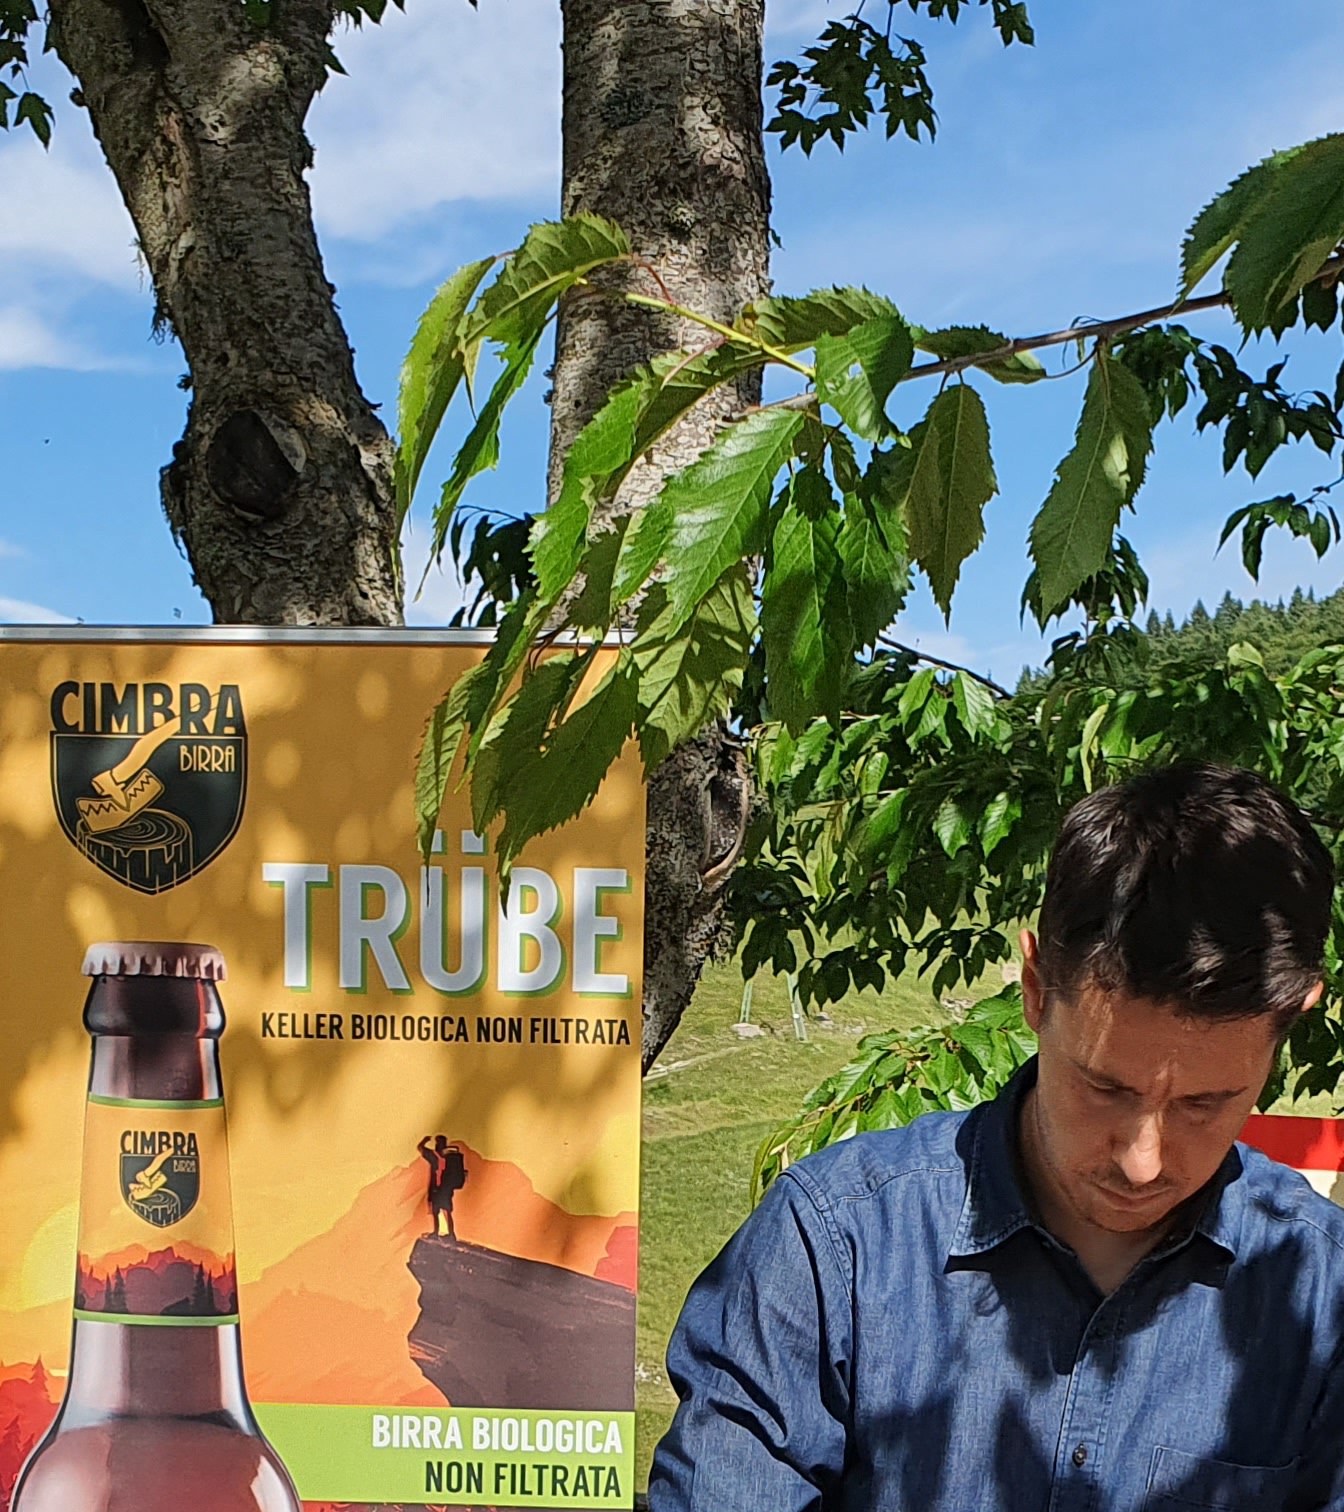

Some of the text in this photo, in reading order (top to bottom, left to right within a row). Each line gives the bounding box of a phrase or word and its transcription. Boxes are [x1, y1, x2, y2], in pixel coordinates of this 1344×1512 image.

[50, 681, 243, 734] CIMBRA
[179, 744, 236, 774] BIRRA
[262, 830, 629, 995] TRÜBE
[261, 1012, 631, 1047] KELLER BIOLOGICA NON FILTRATA
[120, 1130, 197, 1156] CIMBRA
[372, 1414, 622, 1455] BIRRA BIOLOGICA
[425, 1461, 622, 1499] NON FILTRATA
